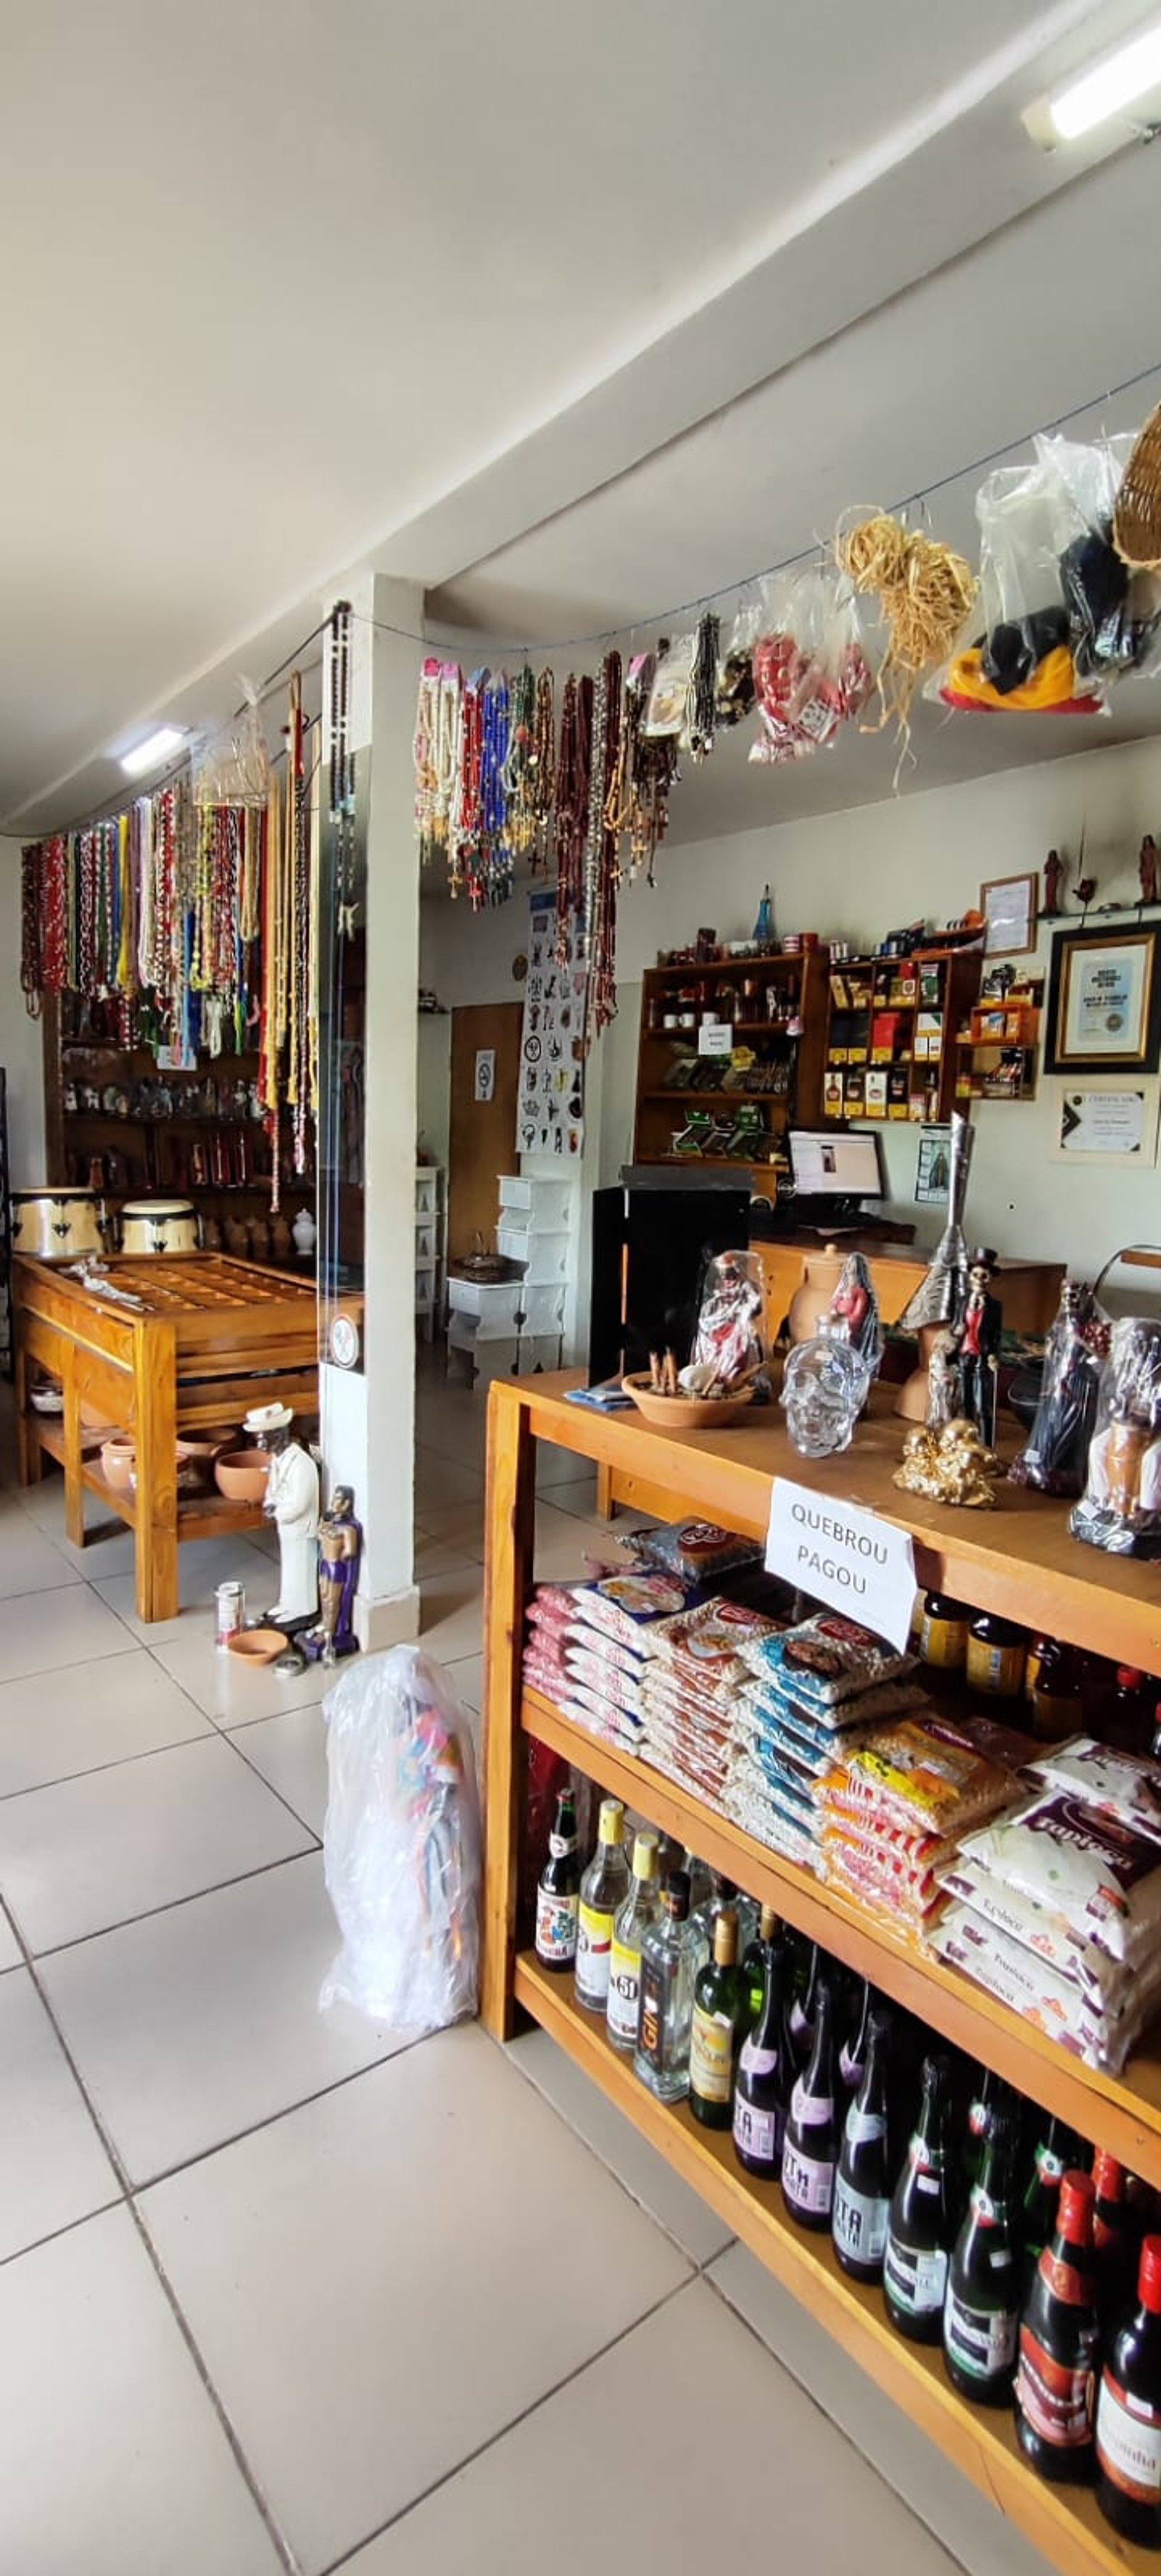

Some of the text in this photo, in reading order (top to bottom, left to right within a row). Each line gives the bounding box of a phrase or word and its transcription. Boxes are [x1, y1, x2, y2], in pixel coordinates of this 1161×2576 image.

[792, 1503, 888, 1564] QUEBROU
[798, 1544, 866, 1594] PAGOU
[619, 1976, 635, 1999] 51
